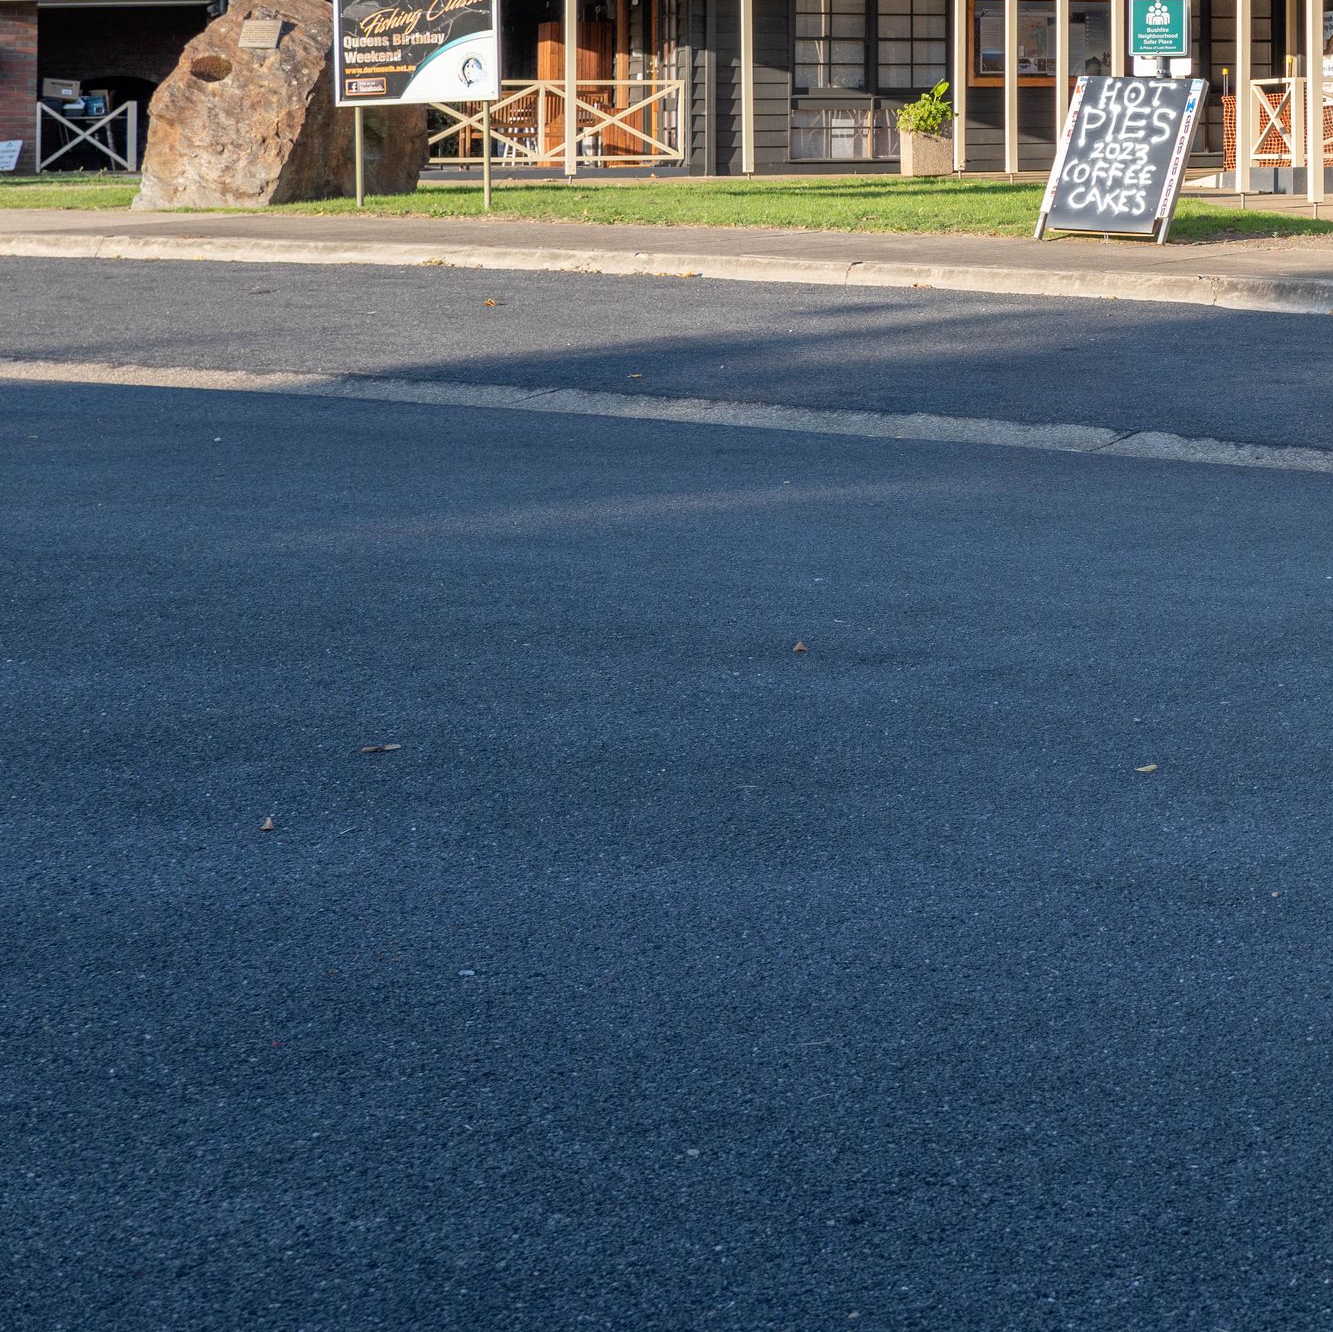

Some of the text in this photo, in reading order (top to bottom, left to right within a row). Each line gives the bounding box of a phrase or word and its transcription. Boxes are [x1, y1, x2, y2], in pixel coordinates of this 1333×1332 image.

[360, 8, 423, 39] Fishing
[343, 32, 445, 49] Queens Birthday
[344, 49, 401, 64] Weekend
[1098, 78, 1177, 109] HOT
[1078, 105, 1177, 147] PIES
[1062, 159, 1157, 186] COFFEE
[1067, 186, 1147, 215] CAKES
